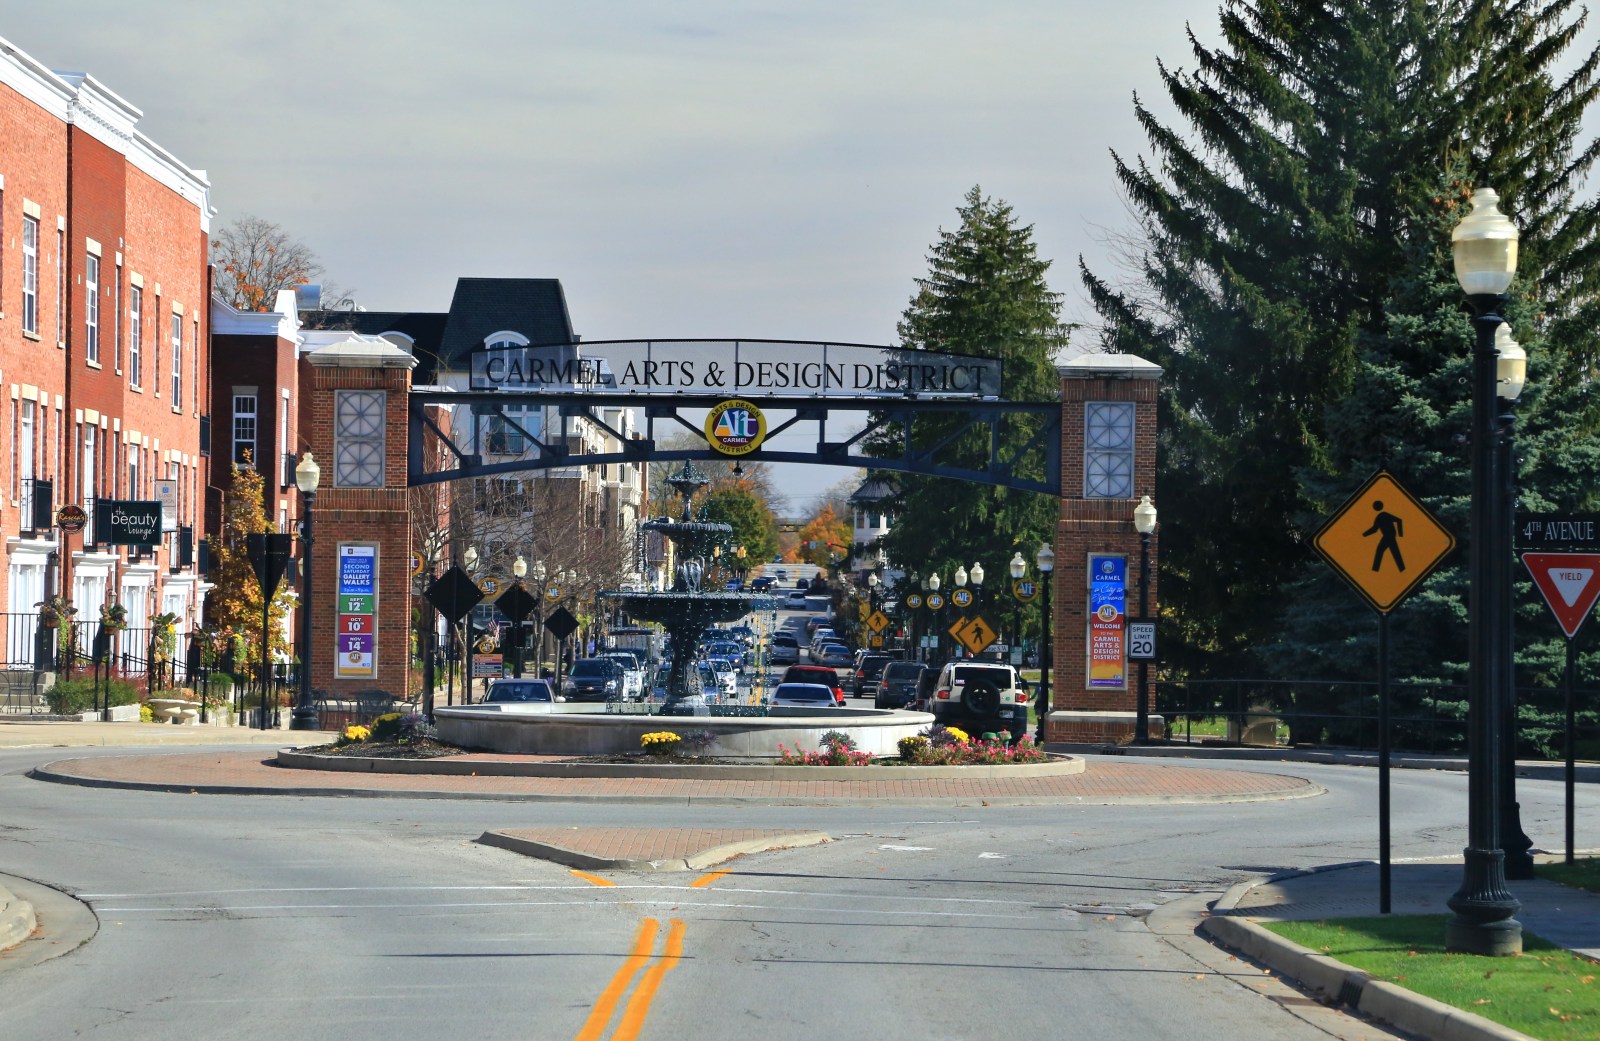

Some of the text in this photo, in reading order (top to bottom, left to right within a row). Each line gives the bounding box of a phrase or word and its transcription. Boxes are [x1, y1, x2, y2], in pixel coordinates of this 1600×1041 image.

[486, 357, 987, 390] CARMEL ARTS & DESIGN DISTRICT
[711, 403, 728, 418] ARTS
[736, 402, 761, 418] DESIGN
[718, 443, 753, 453] DISTRICT
[115, 506, 125, 516] the
[111, 512, 157, 528] beauty
[1544, 521, 1594, 540] AVENUE
[1559, 572, 1582, 580] YIELD
[1132, 641, 1153, 654] 20
